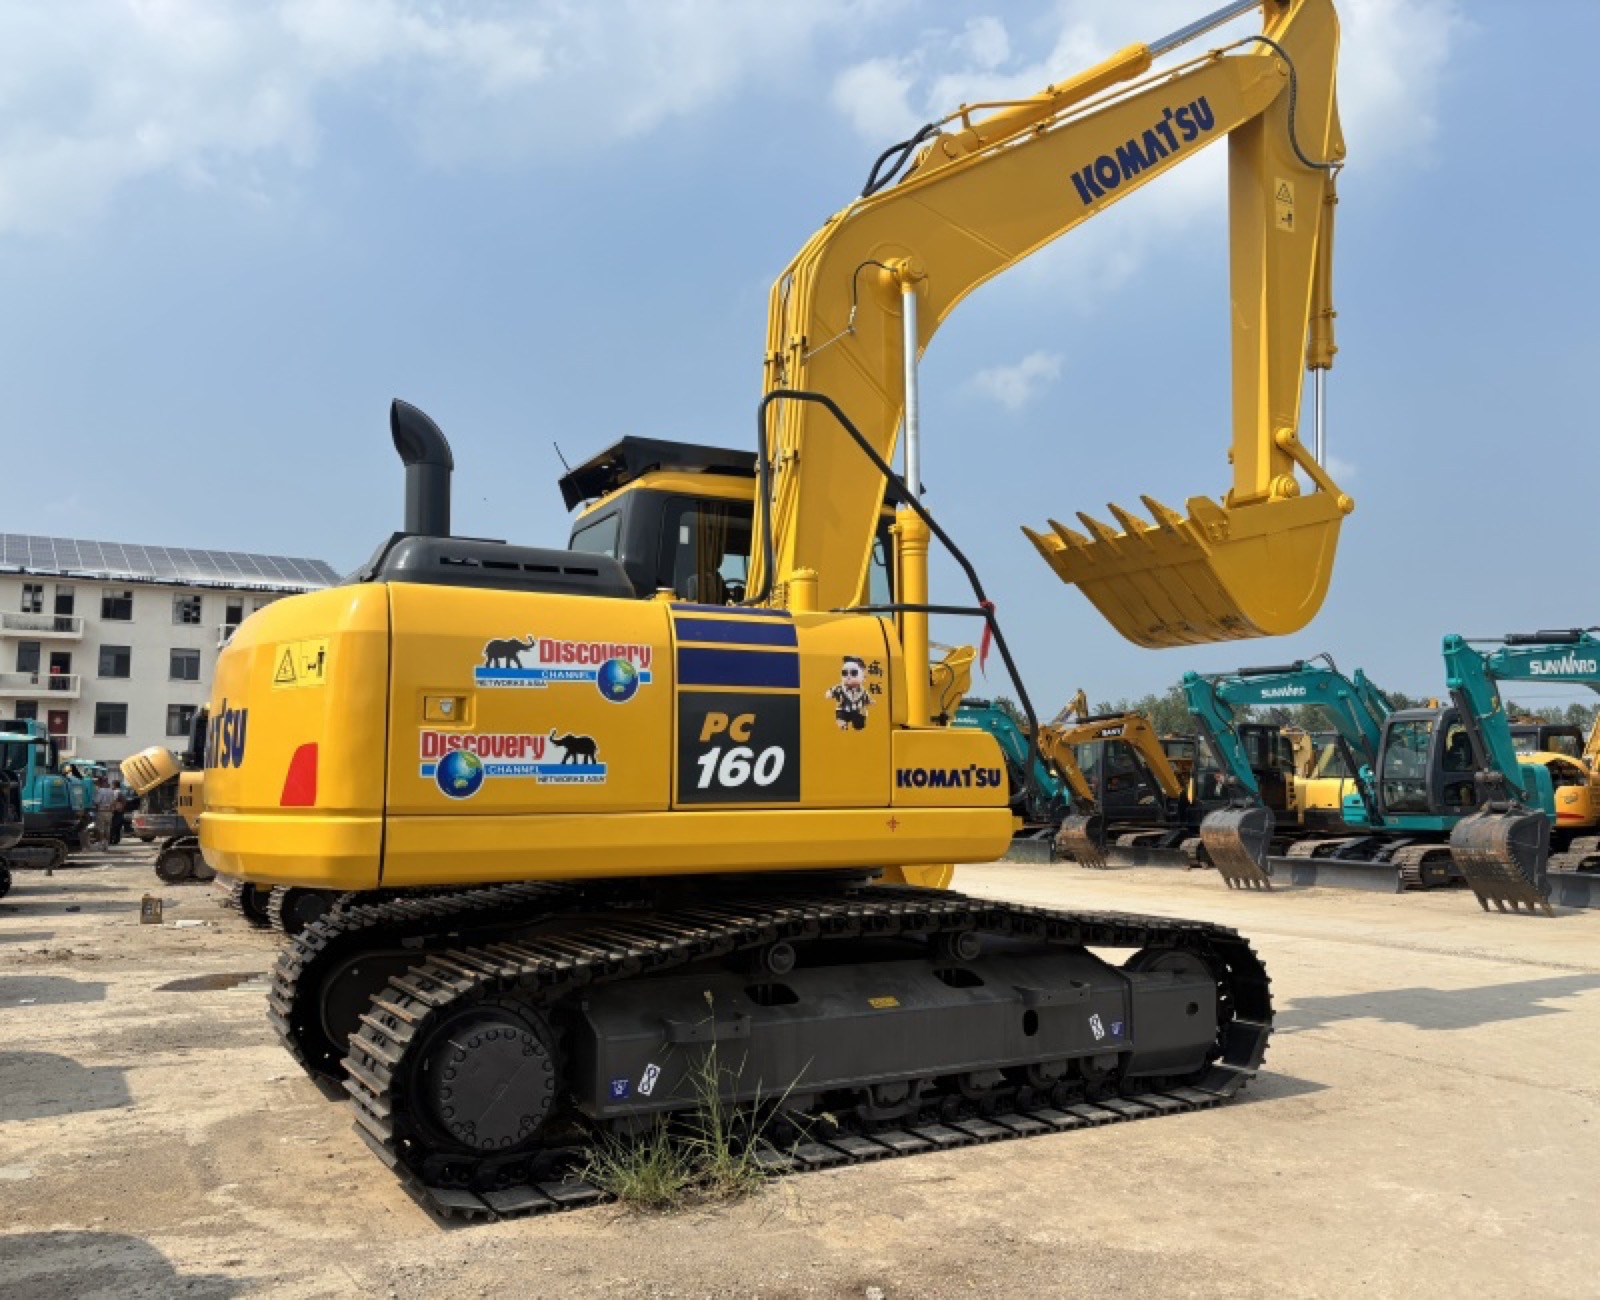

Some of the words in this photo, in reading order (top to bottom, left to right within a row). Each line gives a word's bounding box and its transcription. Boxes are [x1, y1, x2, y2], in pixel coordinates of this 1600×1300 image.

[1070, 95, 1215, 206] KOMATSU
[539, 639, 651, 669] Discovery
[1529, 650, 1597, 675] SUNWARD
[541, 670, 593, 679] CHANNEL
[699, 711, 756, 743] PC
[421, 732, 545, 760] Discovery
[487, 765, 543, 774] CHANNEL
[697, 745, 785, 789] 160
[896, 763, 1001, 789] KOMATSU
